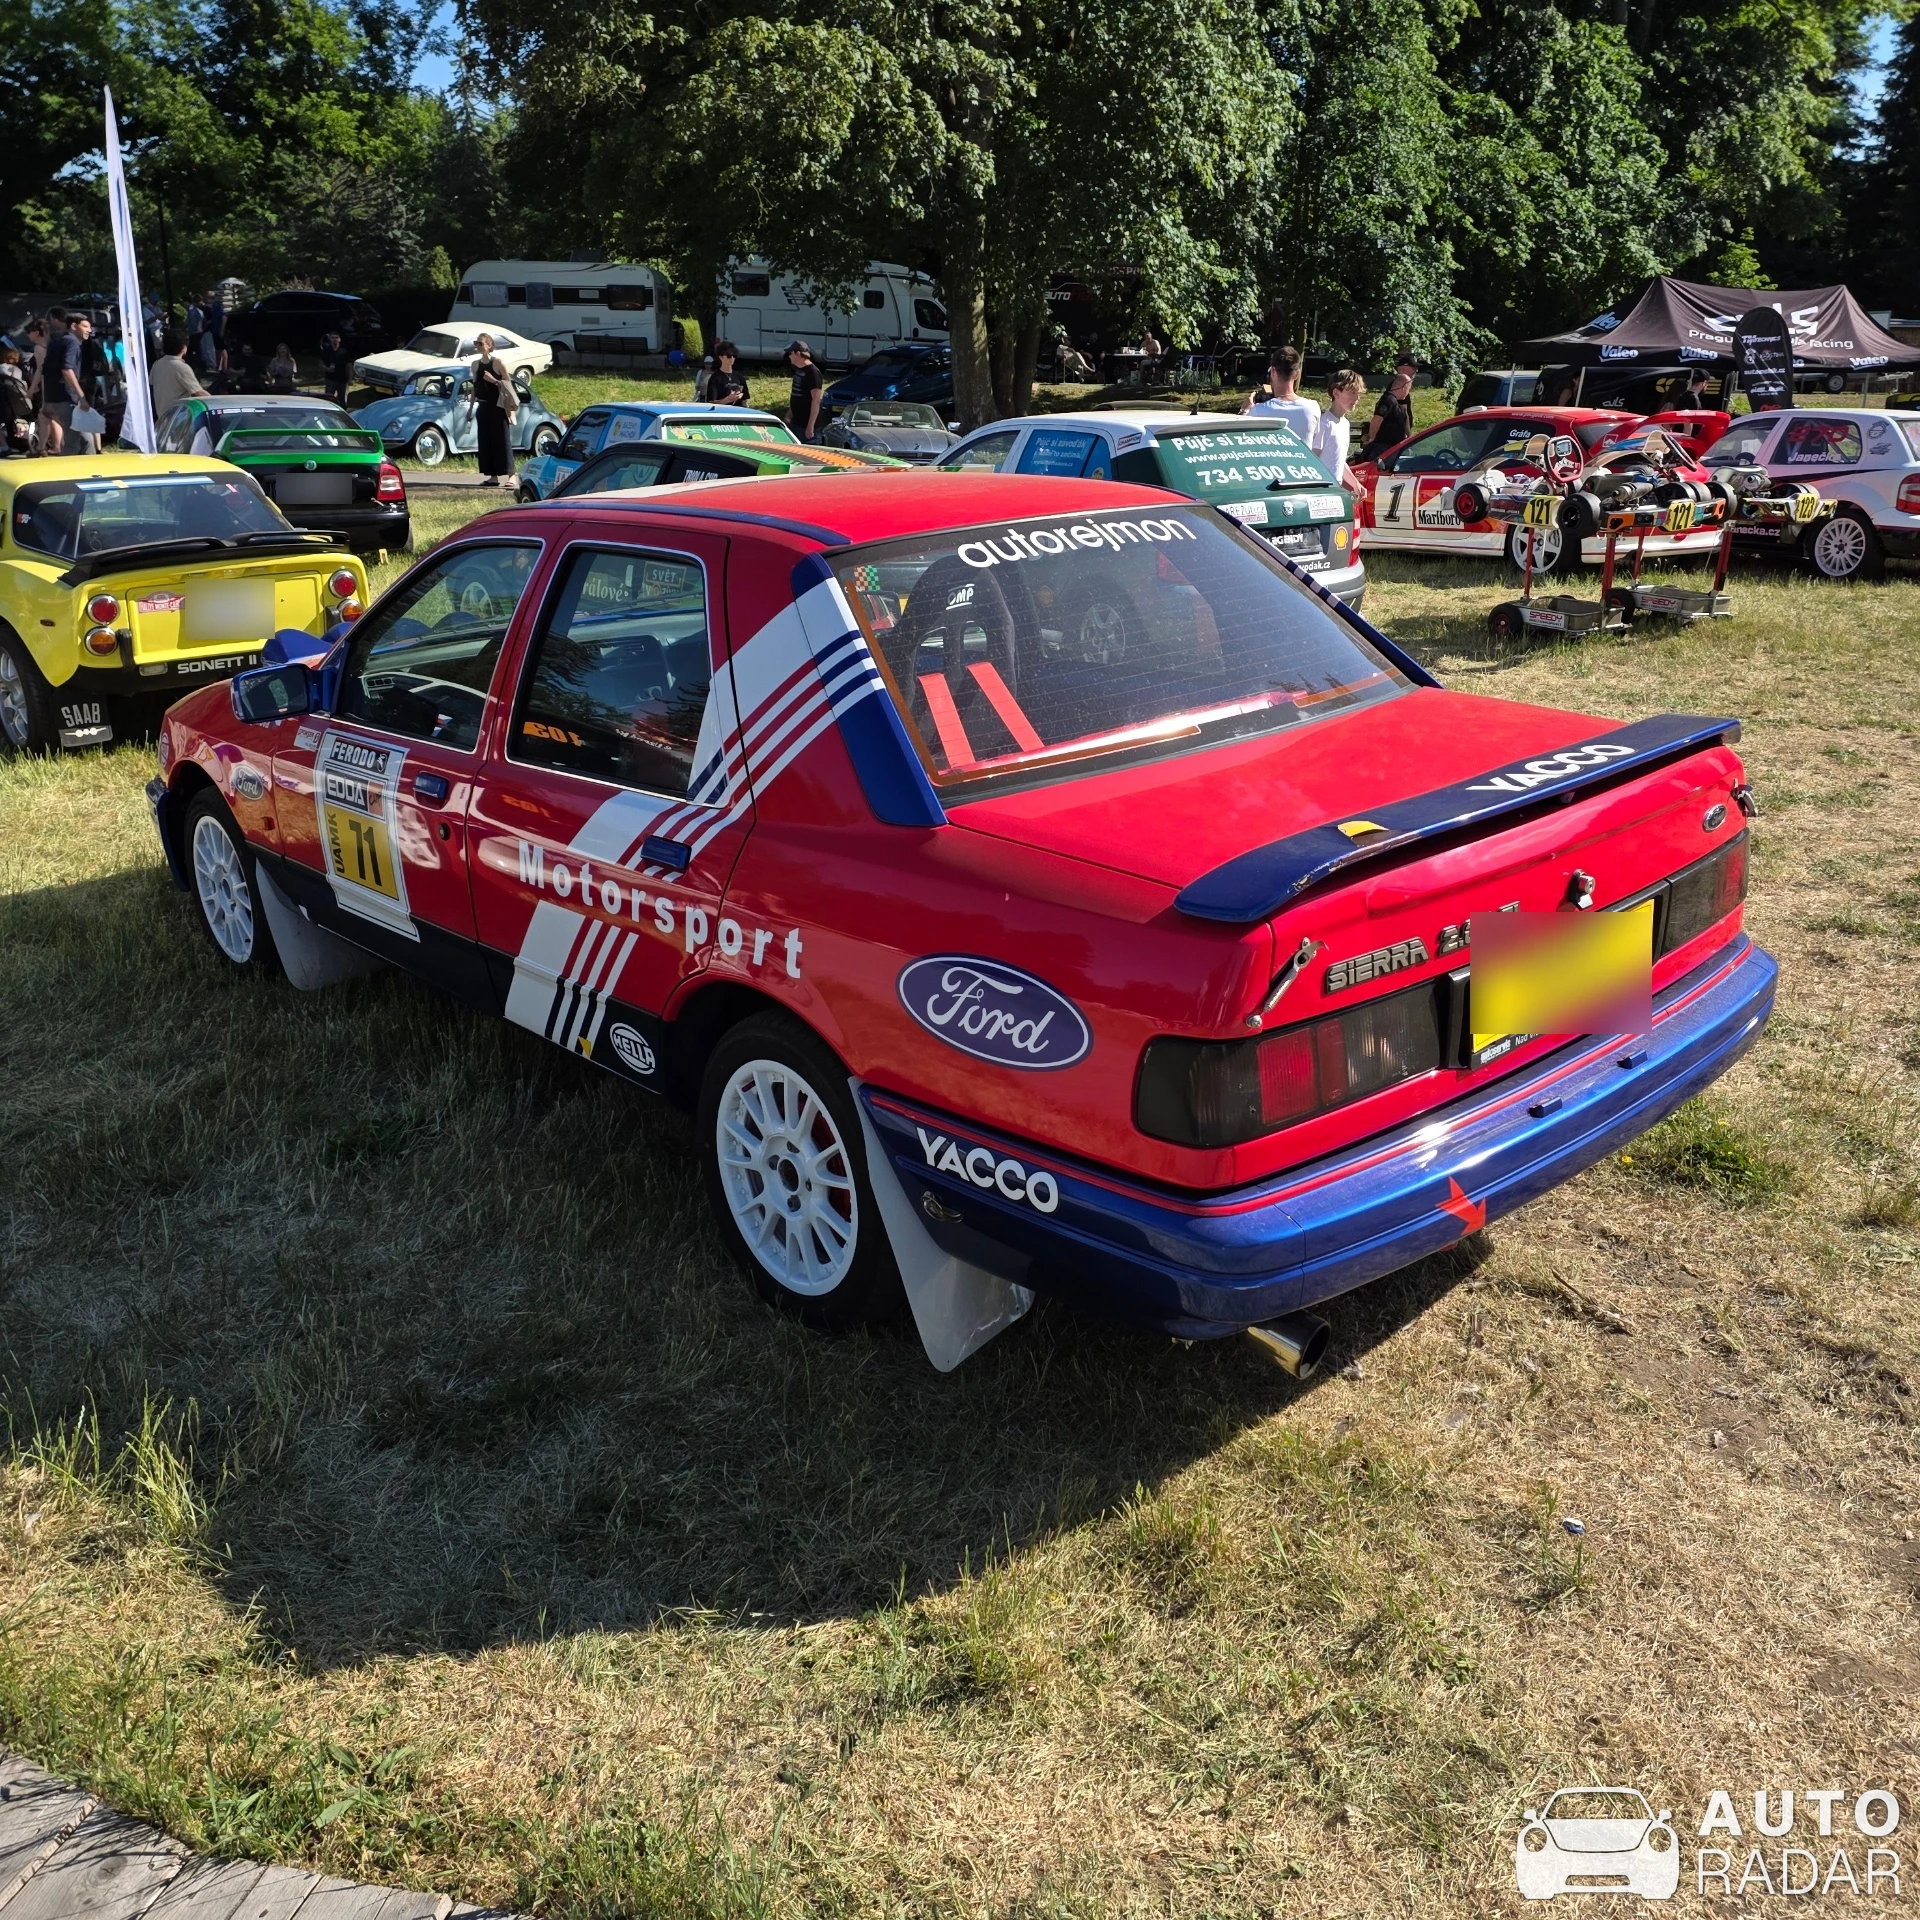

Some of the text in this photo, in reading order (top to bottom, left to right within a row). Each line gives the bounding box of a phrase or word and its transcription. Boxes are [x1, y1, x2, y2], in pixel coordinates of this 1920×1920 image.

[1601, 344, 1639, 361] Valeo
[1688, 329, 1733, 344] Pragu
[1809, 337, 1854, 351] racing
[1680, 346, 1718, 361] Valeo
[1850, 355, 1889, 369] Valeo
[1171, 434, 1215, 451] Půjč
[1216, 433, 1233, 447] si
[1509, 429, 1532, 439] Gráfa
[1184, 450, 1307, 464] www.pujcsizavodak.cz
[1196, 465, 1323, 486] 734 500 648
[1383, 483, 1405, 522] 1
[1530, 499, 1551, 525] 121
[1799, 496, 1815, 519] 123
[1418, 510, 1461, 527] Marlboro
[1672, 501, 1693, 530] 121
[956, 517, 1197, 568] autorejmon
[1731, 525, 1781, 537] anecka.cz
[583, 578, 624, 603] rálové
[947, 586, 974, 606] OMP
[1529, 611, 1563, 622] SPEEDY
[178, 656, 244, 674] SONETT
[61, 703, 101, 728] SAAB
[331, 741, 377, 768] FERODO
[1465, 744, 1636, 793] YACCO
[327, 773, 366, 807] EDDA
[349, 819, 383, 888] 71
[518, 839, 803, 979] Motorsport
[1327, 936, 1431, 993] SIERRA
[926, 966, 1055, 1053] Ford
[612, 1033, 656, 1068] HELLA
[916, 1127, 1059, 1213] YACCO
